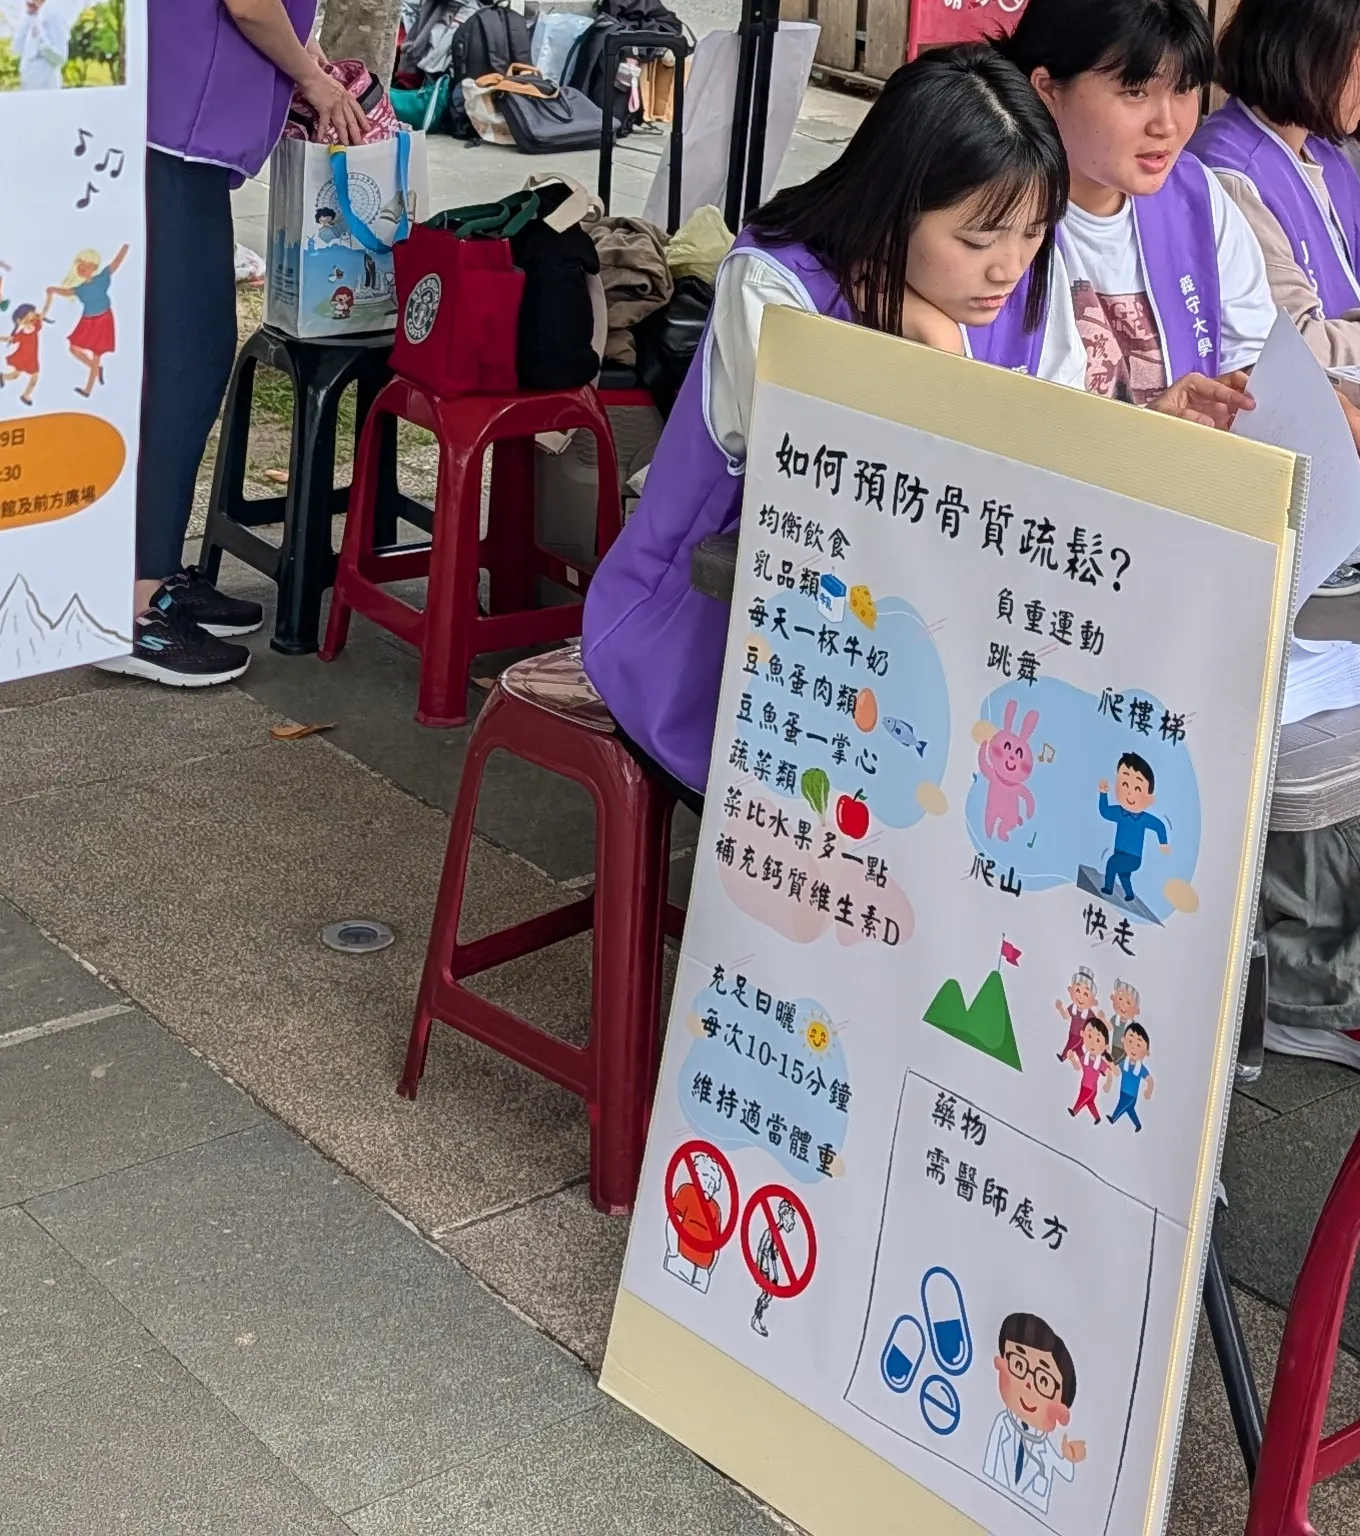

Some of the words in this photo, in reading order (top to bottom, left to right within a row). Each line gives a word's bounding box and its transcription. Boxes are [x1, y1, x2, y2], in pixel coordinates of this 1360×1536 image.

[1179, 274, 1214, 359] 義守大學
[759, 504, 851, 561] 均衡飲食
[775, 432, 1131, 592] 如何預防骨質疏鬆?
[752, 548, 820, 601] 乳品類
[748, 596, 889, 677] 每天一杯牛奶
[996, 587, 1105, 656] 負重運動
[742, 645, 859, 720] 豆魚蛋肉類
[987, 642, 1041, 687] 跳舞
[736, 692, 880, 775] 豆魚蛋一掌心
[1098, 686, 1186, 747] 爬樓梯
[728, 738, 798, 795] 蔬菜類
[723, 786, 889, 889] 菜比水果多一點
[715, 832, 900, 947] 補充鈣質維生素D
[971, 852, 1023, 898] 爬山
[1082, 903, 1137, 957] 快走
[708, 963, 797, 1035] 充足日曬
[701, 1007, 852, 1114] 每次10-15分鐘
[691, 1070, 837, 1179] 維持適當體重
[932, 1091, 987, 1146] 藥物
[926, 1147, 1069, 1251] 需醫師處方
